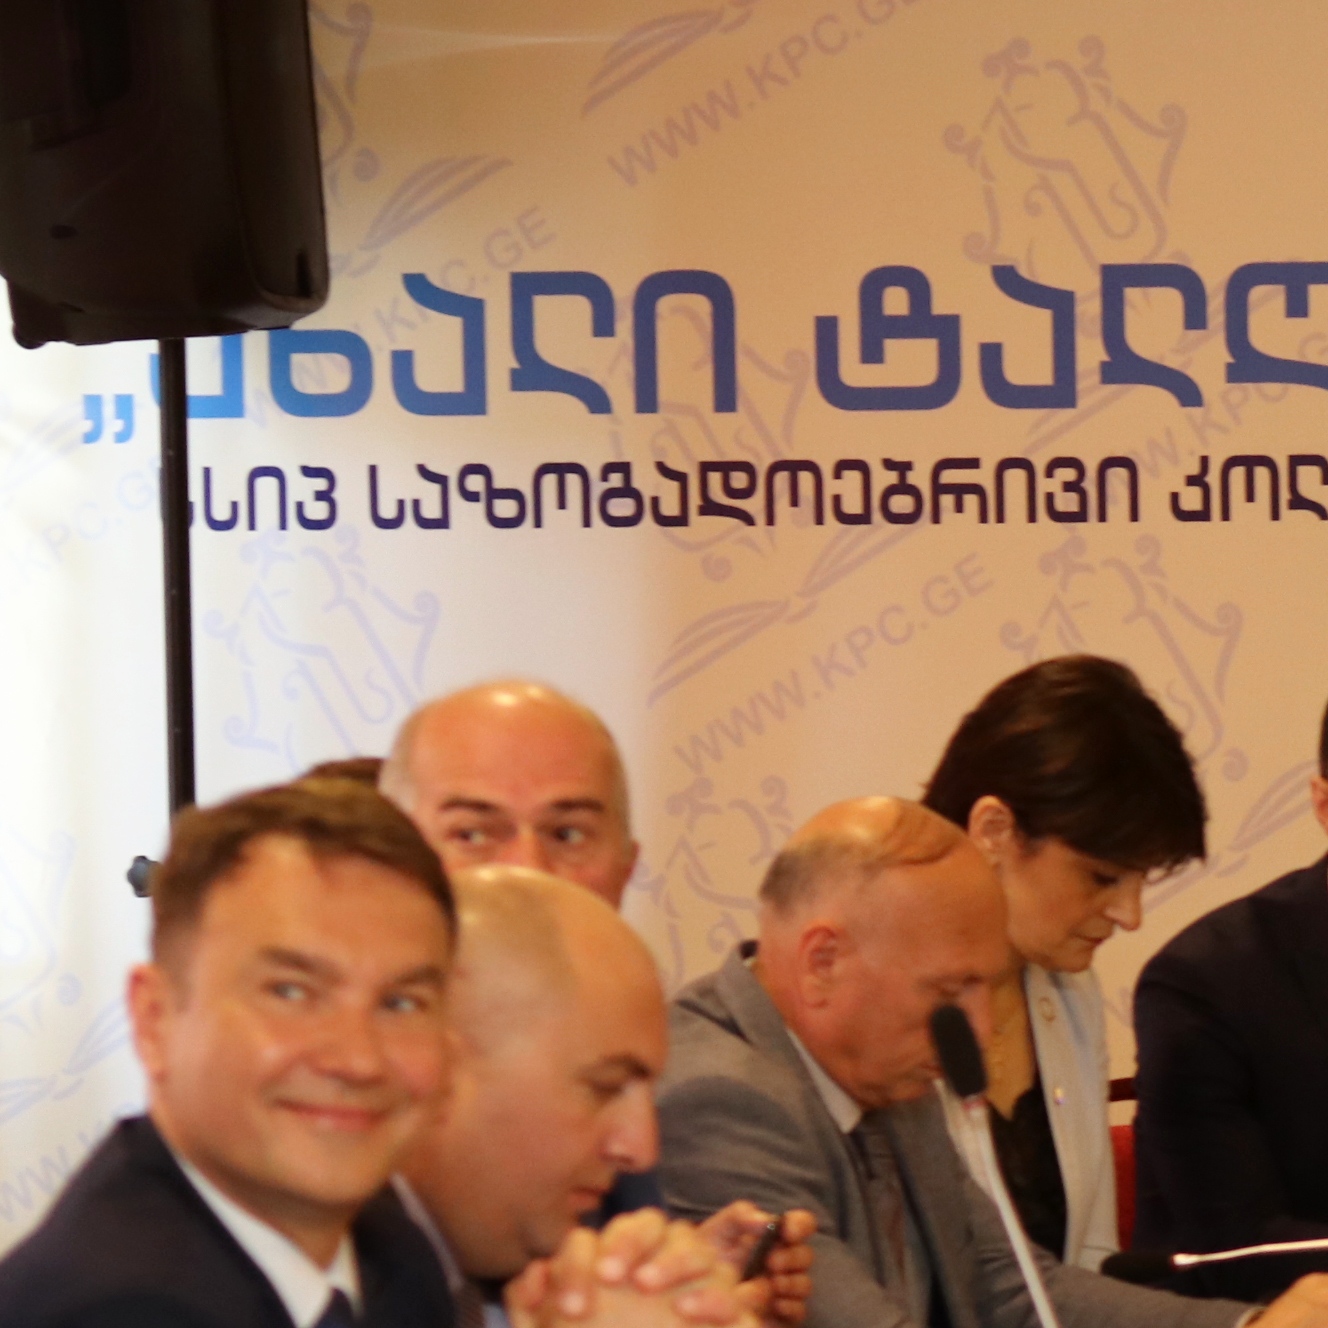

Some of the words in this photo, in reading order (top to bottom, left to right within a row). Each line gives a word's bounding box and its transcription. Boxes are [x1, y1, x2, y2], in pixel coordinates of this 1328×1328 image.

[160, 465, 337, 532] სიპ
[368, 456, 1139, 531] საზოგადოებრივი
[673, 552, 995, 778] WWW.KPC.GE
